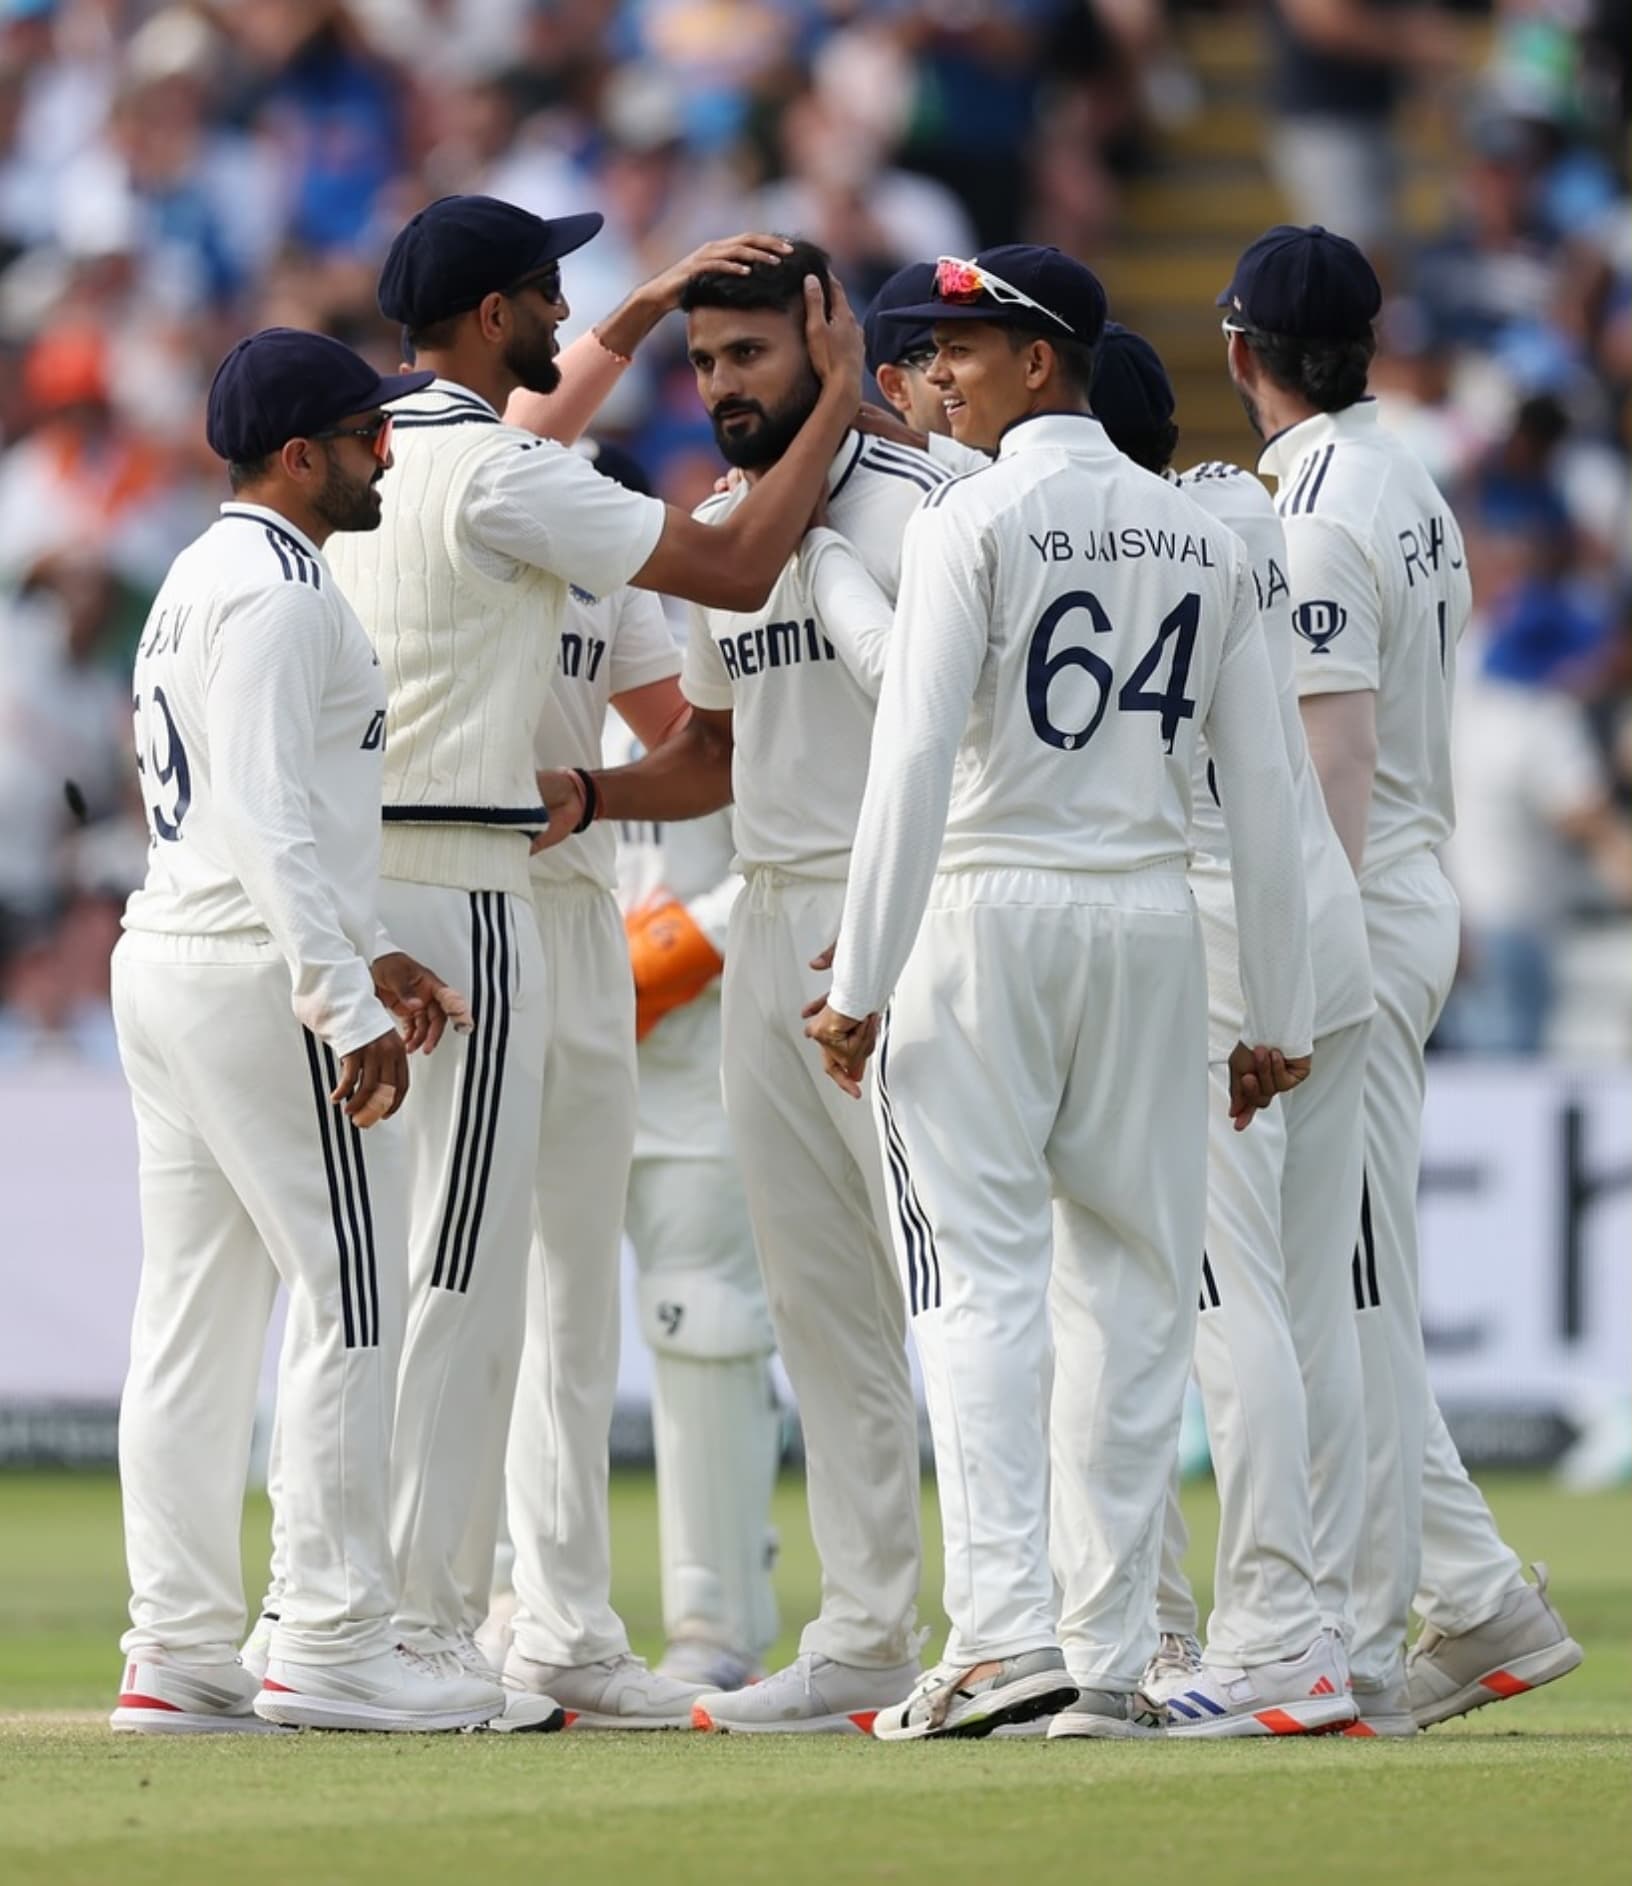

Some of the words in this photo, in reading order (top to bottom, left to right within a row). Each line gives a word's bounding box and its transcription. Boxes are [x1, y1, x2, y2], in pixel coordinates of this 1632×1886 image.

[1029, 530, 1073, 562] YB
[1084, 528, 1214, 567] JAISWAL
[1026, 590, 1201, 755] 64
